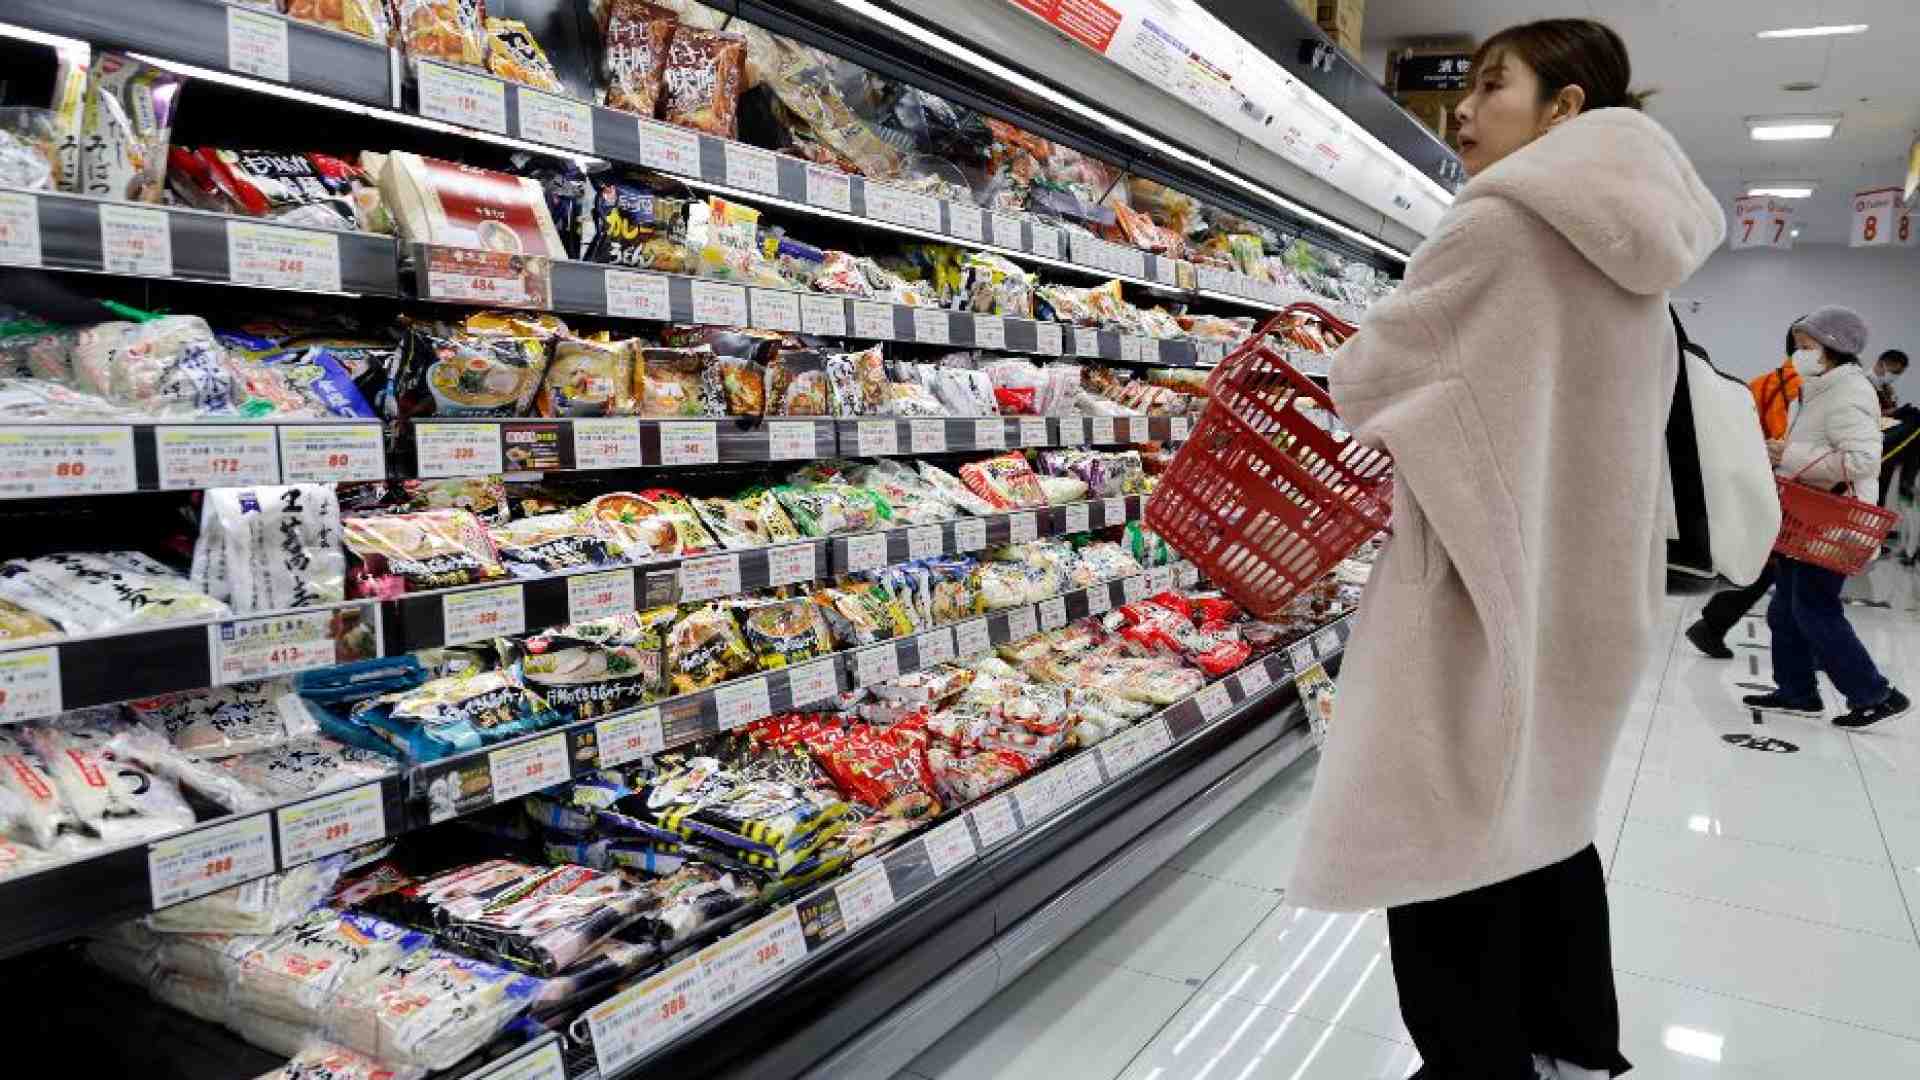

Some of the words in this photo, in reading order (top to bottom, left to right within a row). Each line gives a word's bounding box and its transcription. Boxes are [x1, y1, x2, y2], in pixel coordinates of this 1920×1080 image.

[606, 208, 657, 239] カレー
[1742, 219, 1754, 243] 7
[1773, 219, 1785, 243] 7
[1863, 215, 1877, 241] 8
[1899, 215, 1909, 241] 8
[471, 279, 496, 290] 484
[56, 462, 85, 477] 80
[212, 458, 240, 472] 172
[328, 454, 349, 466] 80
[271, 647, 298, 662] 413
